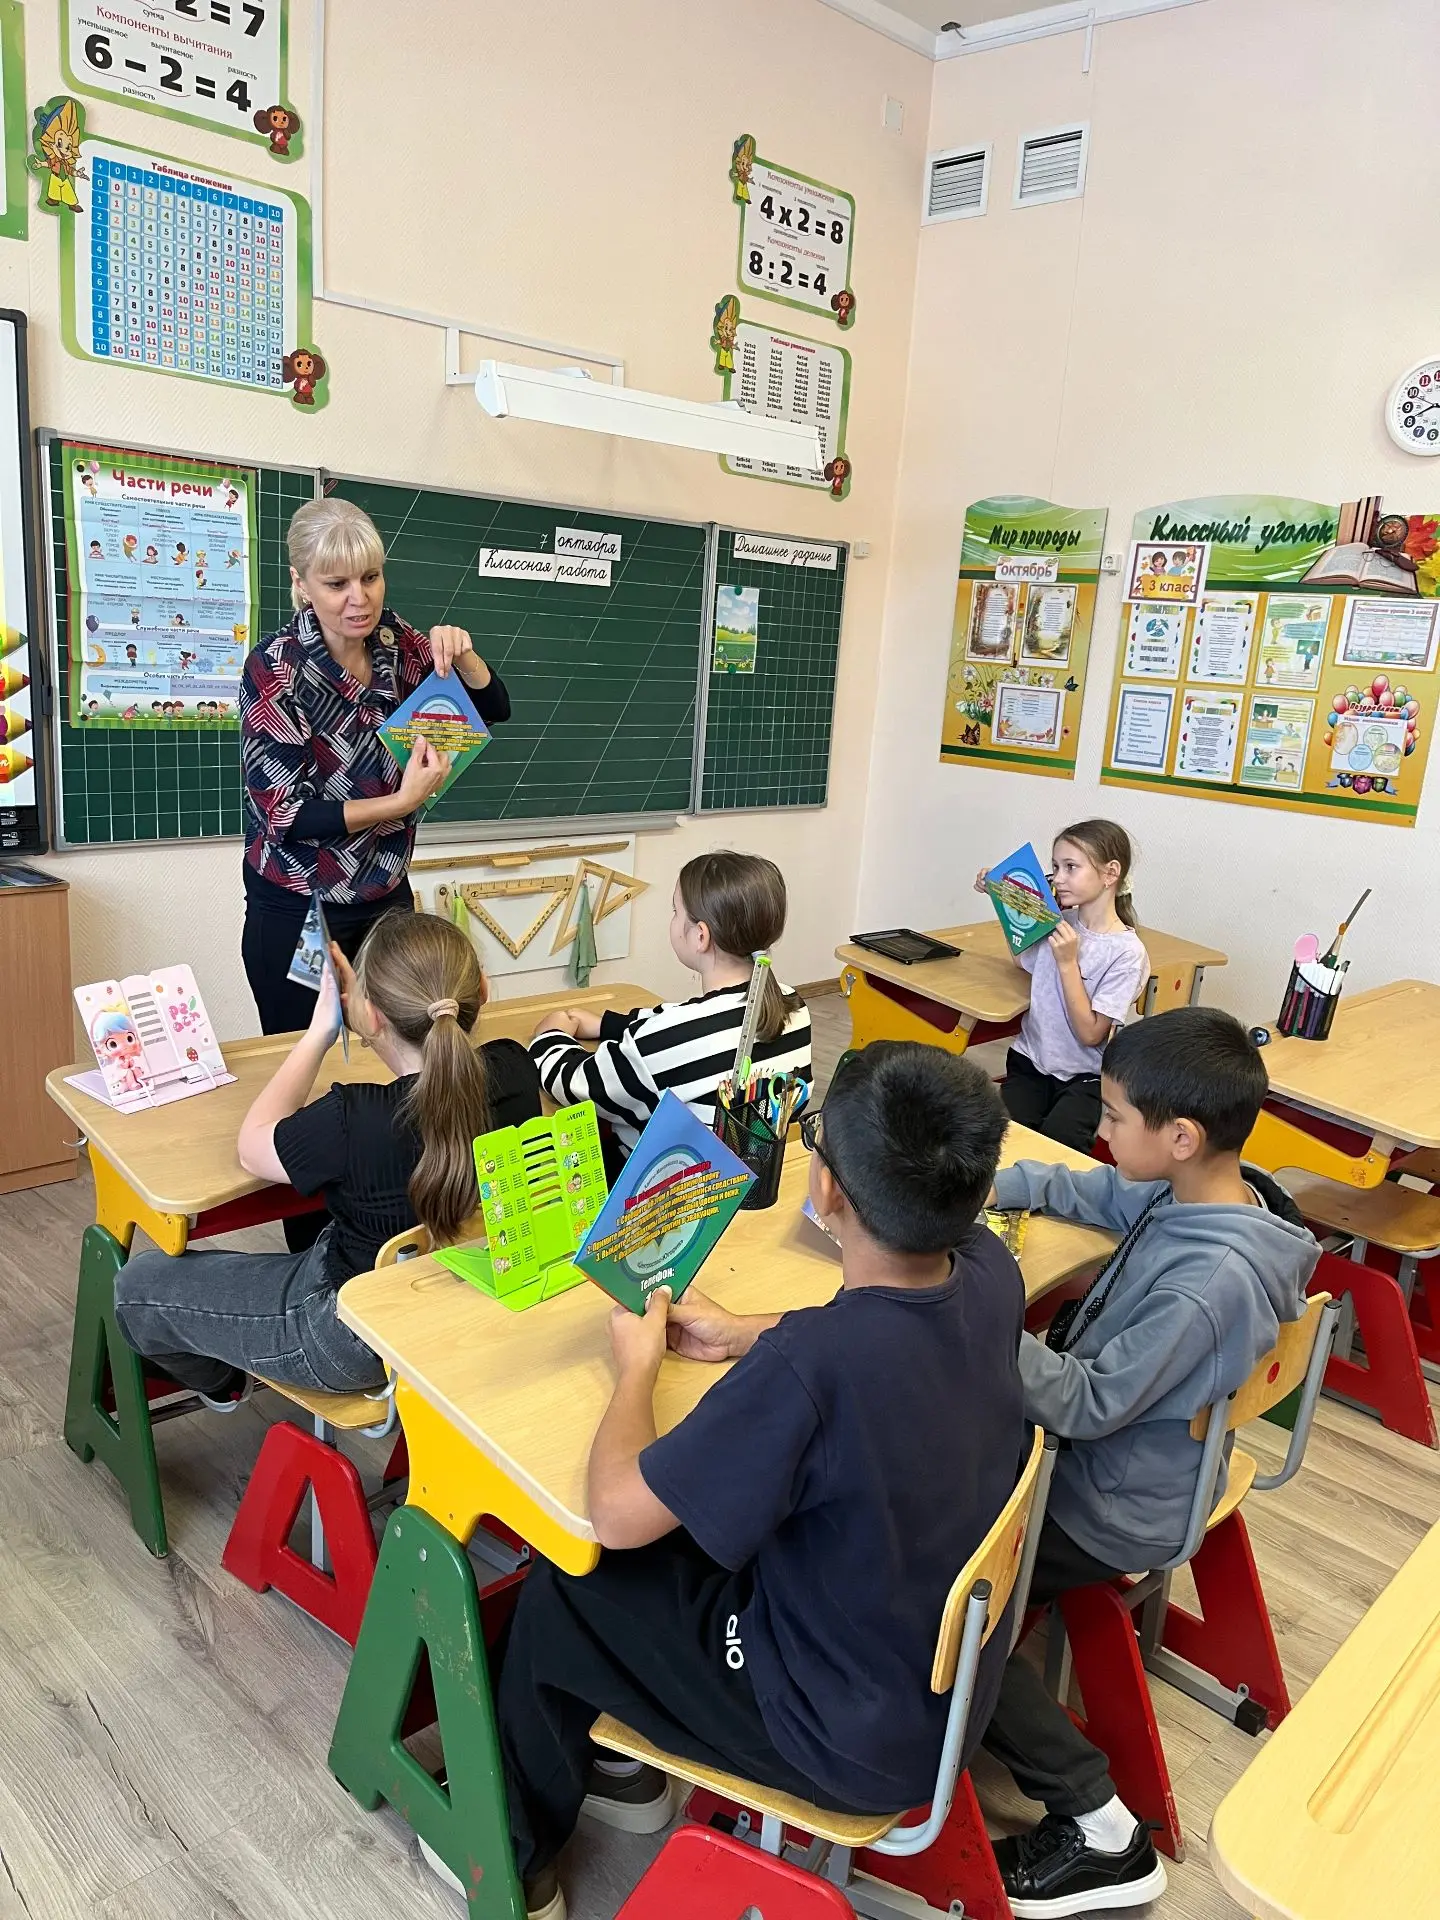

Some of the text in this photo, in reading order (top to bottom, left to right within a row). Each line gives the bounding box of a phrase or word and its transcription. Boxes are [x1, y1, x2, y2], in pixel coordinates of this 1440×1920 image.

[143, 9, 165, 21] сумма
[242, 2, 265, 38] 7
[77, 17, 128, 39] уменьшаемое
[96, 5, 170, 39] Компоненты
[173, 33, 233, 59] вычитания
[151, 41, 194, 60] вычитаемое
[84, 33, 113, 69] 6
[160, 55, 183, 93] 2
[225, 79, 251, 112] 4
[227, 66, 257, 80] разность
[122, 86, 156, 100] разность
[151, 162, 233, 191] Таблица сложения
[271, 209, 280, 219] 10
[760, 195, 775, 220] 4
[798, 207, 810, 233] 2
[830, 220, 844, 244] 8
[271, 225, 281, 234] 10
[256, 236, 266, 245] 10
[271, 240, 281, 249] 11
[749, 250, 763, 275] 8
[781, 260, 792, 285] 2
[813, 273, 827, 295] 4
[1421, 376, 1429, 386] 11
[1409, 388, 1418, 397] 10
[1405, 404, 1411, 412] 9
[1407, 417, 1413, 426] 8
[1416, 427, 1422, 436] 7
[1430, 430, 1436, 439] 6
[112, 468, 213, 497] Части речи
[540, 533, 549, 549] 7
[989, 525, 1082, 551] Мир природы
[1150, 513, 1333, 553] Классный уголок
[557, 533, 618, 559] октября
[734, 535, 832, 565] Домашнее задание
[484, 549, 607, 582] Классная работа
[1001, 563, 1052, 580] октябрь
[1150, 582, 1156, 591] 3
[1160, 582, 1197, 593] класс
[1350, 703, 1404, 713] Поздравляем!
[641, 1268, 675, 1291] Телефон:
